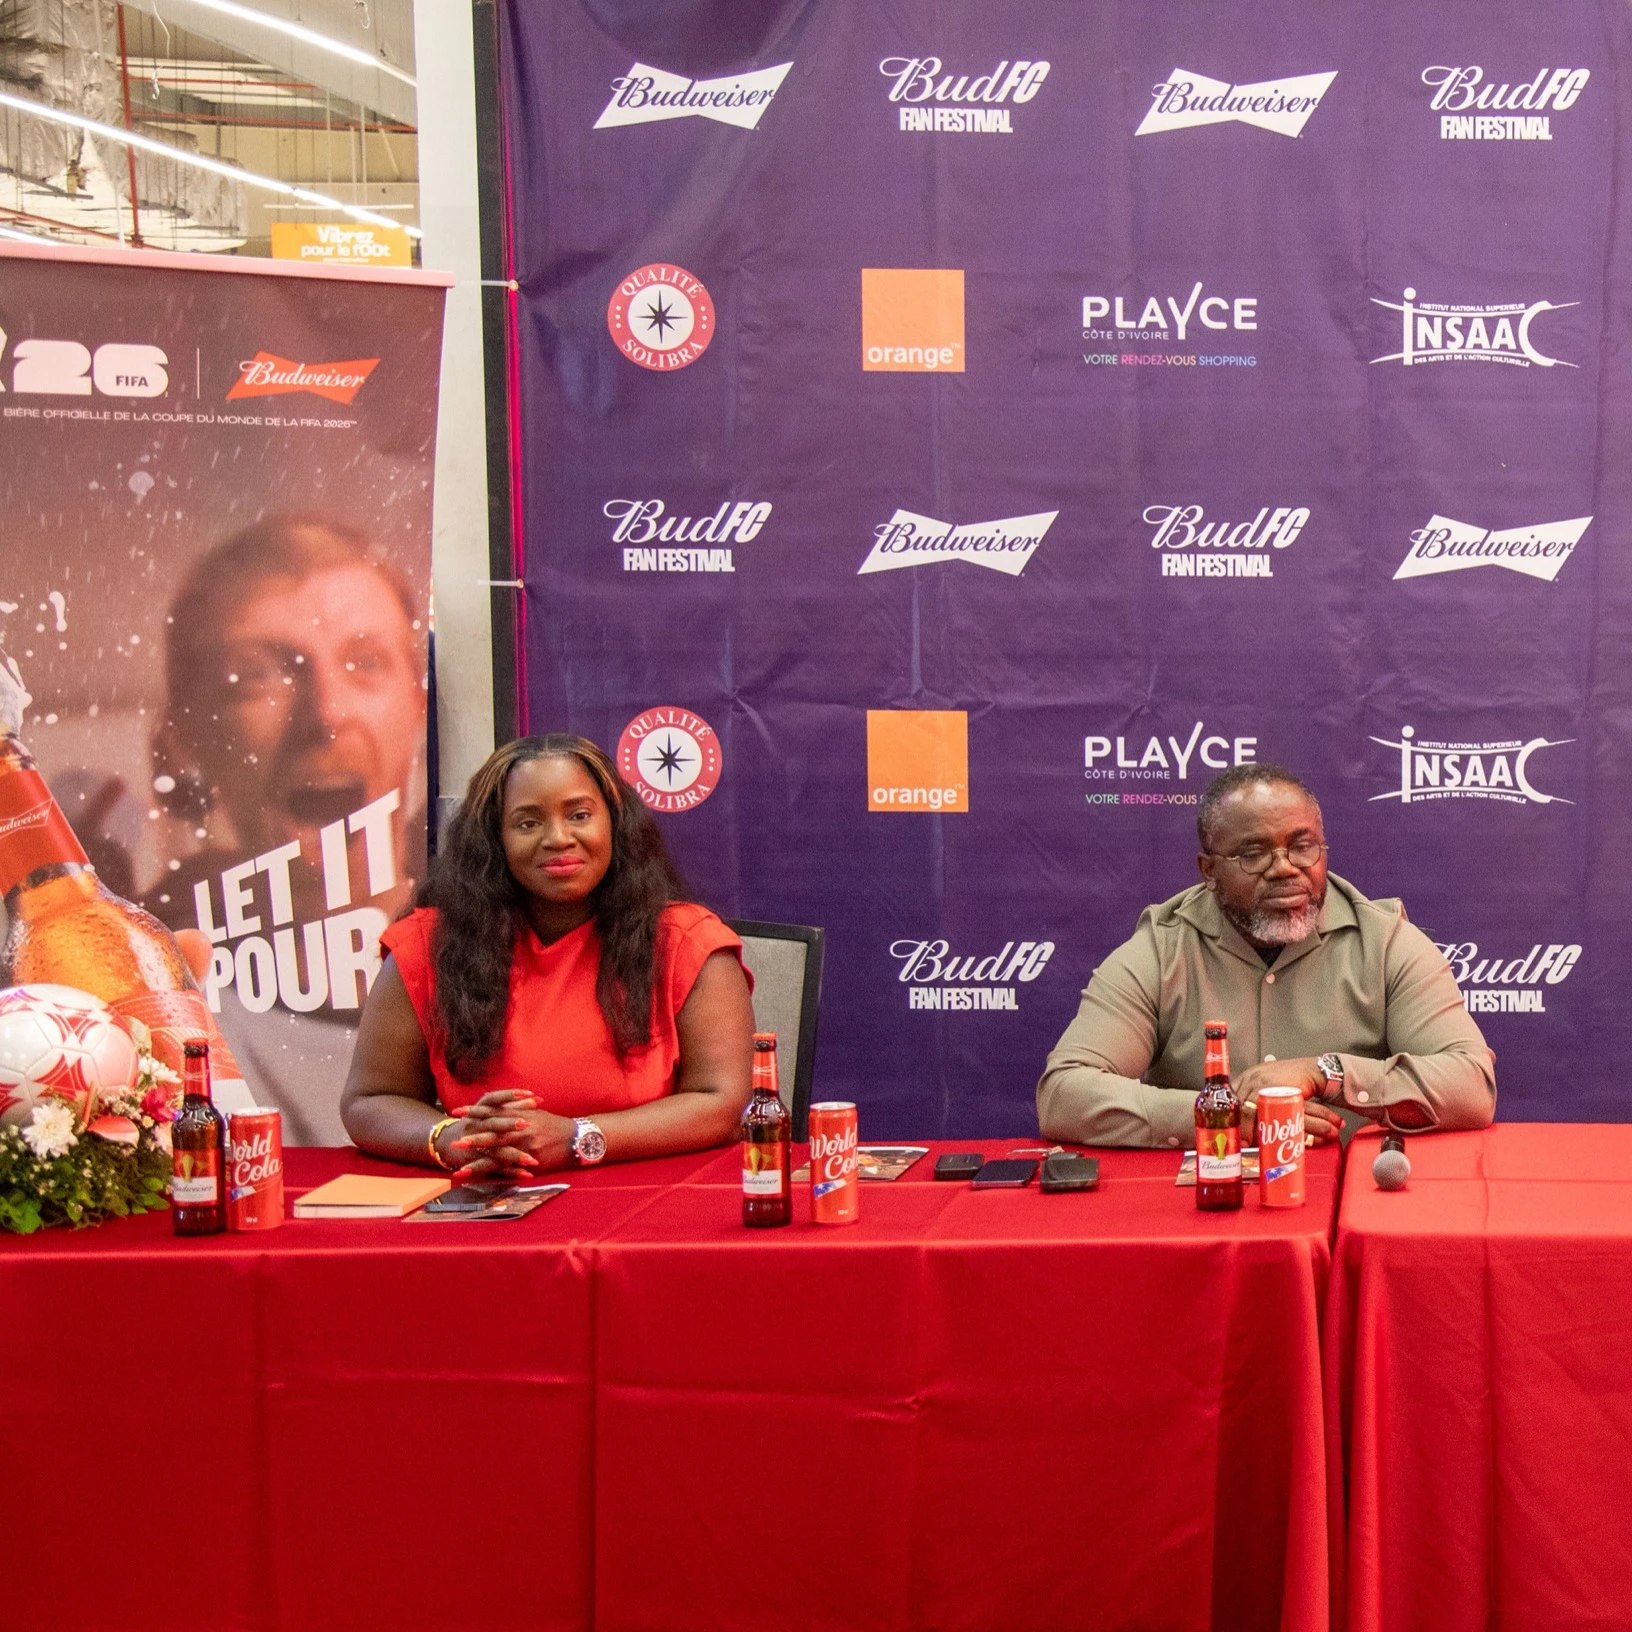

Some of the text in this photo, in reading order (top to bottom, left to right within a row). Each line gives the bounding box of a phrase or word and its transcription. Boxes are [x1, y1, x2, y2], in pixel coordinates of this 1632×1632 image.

[610, 77, 775, 109] Budweiser
[1151, 82, 1319, 114] Budweiser
[899, 107, 1013, 133] FAN FESTIVAL
[1440, 115, 1553, 141] FAN FESTIVAL
[316, 225, 374, 244] Vibrez
[301, 244, 334, 258] pour
[337, 243, 351, 257] le
[621, 267, 704, 299] QUALITÉ
[1083, 282, 1257, 340] PLAYCE
[1420, 303, 1449, 311] INSTITUT
[1451, 304, 1484, 312] NATIONAL
[1083, 329, 1169, 340] CÔTE D'IVOIRE
[622, 339, 704, 369] SOLIBRA
[1083, 354, 1257, 367] VOTRE RENDEZ-VOUS SHOPPING
[1414, 356, 1427, 364] DES
[1492, 357, 1530, 368] CULTURELLE
[13, 339, 169, 398] 26
[116, 375, 149, 388] FIFA
[239, 361, 365, 388] Budweiser
[4, 407, 40, 418] BIÈRE
[43, 409, 111, 420] OFFICIELLE
[114, 411, 131, 421] DE
[134, 412, 150, 421] LA
[152, 412, 194, 422] COUPE
[197, 414, 215, 424] DU
[217, 415, 262, 425] MONDE
[265, 417, 281, 426] DE
[283, 418, 298, 427] LA
[300, 418, 322, 428] FIFA
[873, 522, 1040, 553] Budweiser
[1408, 528, 1574, 559] Budweiser
[623, 547, 735, 573] FAN FESTIVAL
[1161, 553, 1273, 578] FAN FESTIVAL
[629, 710, 713, 741] QUALITÉ
[1085, 721, 1257, 779] PLAYCE
[1418, 740, 1447, 749] INSTITUT
[1085, 769, 1170, 780] CÔTE D'IVOIRE
[633, 781, 711, 809] SOLIBRA
[1085, 793, 1120, 805] VOTRE
[1122, 793, 1197, 805] RENDEZ-VOUS
[1489, 794, 1527, 805] CULTURELLE
[193, 787, 400, 944] LET IT
[204, 907, 390, 1013] POUR
[909, 987, 1018, 1011] FAN FESTIVAL
[1470, 989, 1545, 1012] FESTIVAL
[235, 1155, 280, 1186] Cola
